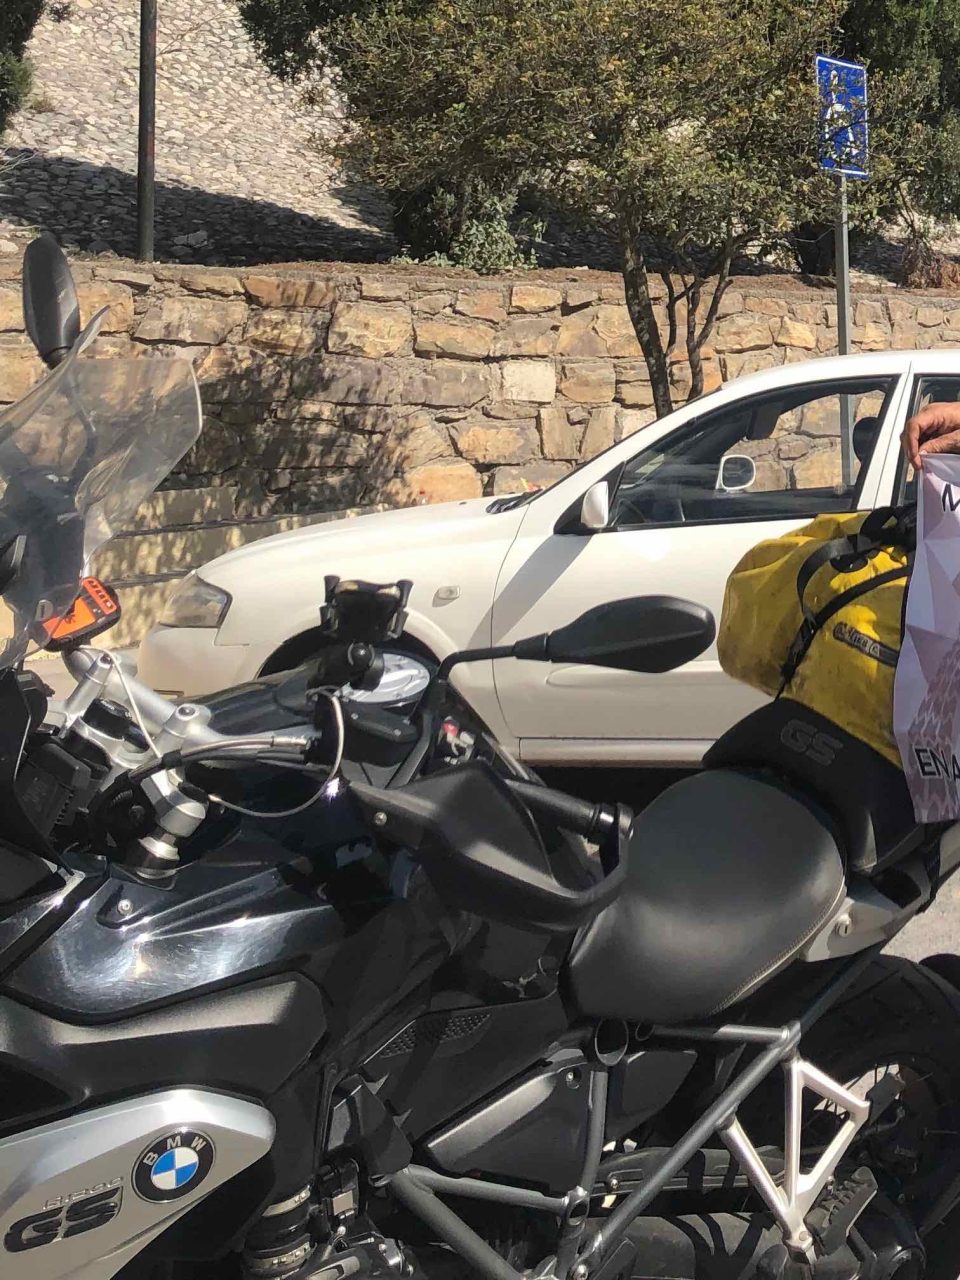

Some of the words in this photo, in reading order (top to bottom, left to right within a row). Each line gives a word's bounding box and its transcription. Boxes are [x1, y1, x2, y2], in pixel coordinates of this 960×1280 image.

[781, 719, 843, 766] GS
[915, 748, 951, 778] EN
[143, 1135, 207, 1166] BMW
[4, 1185, 124, 1253] GS
